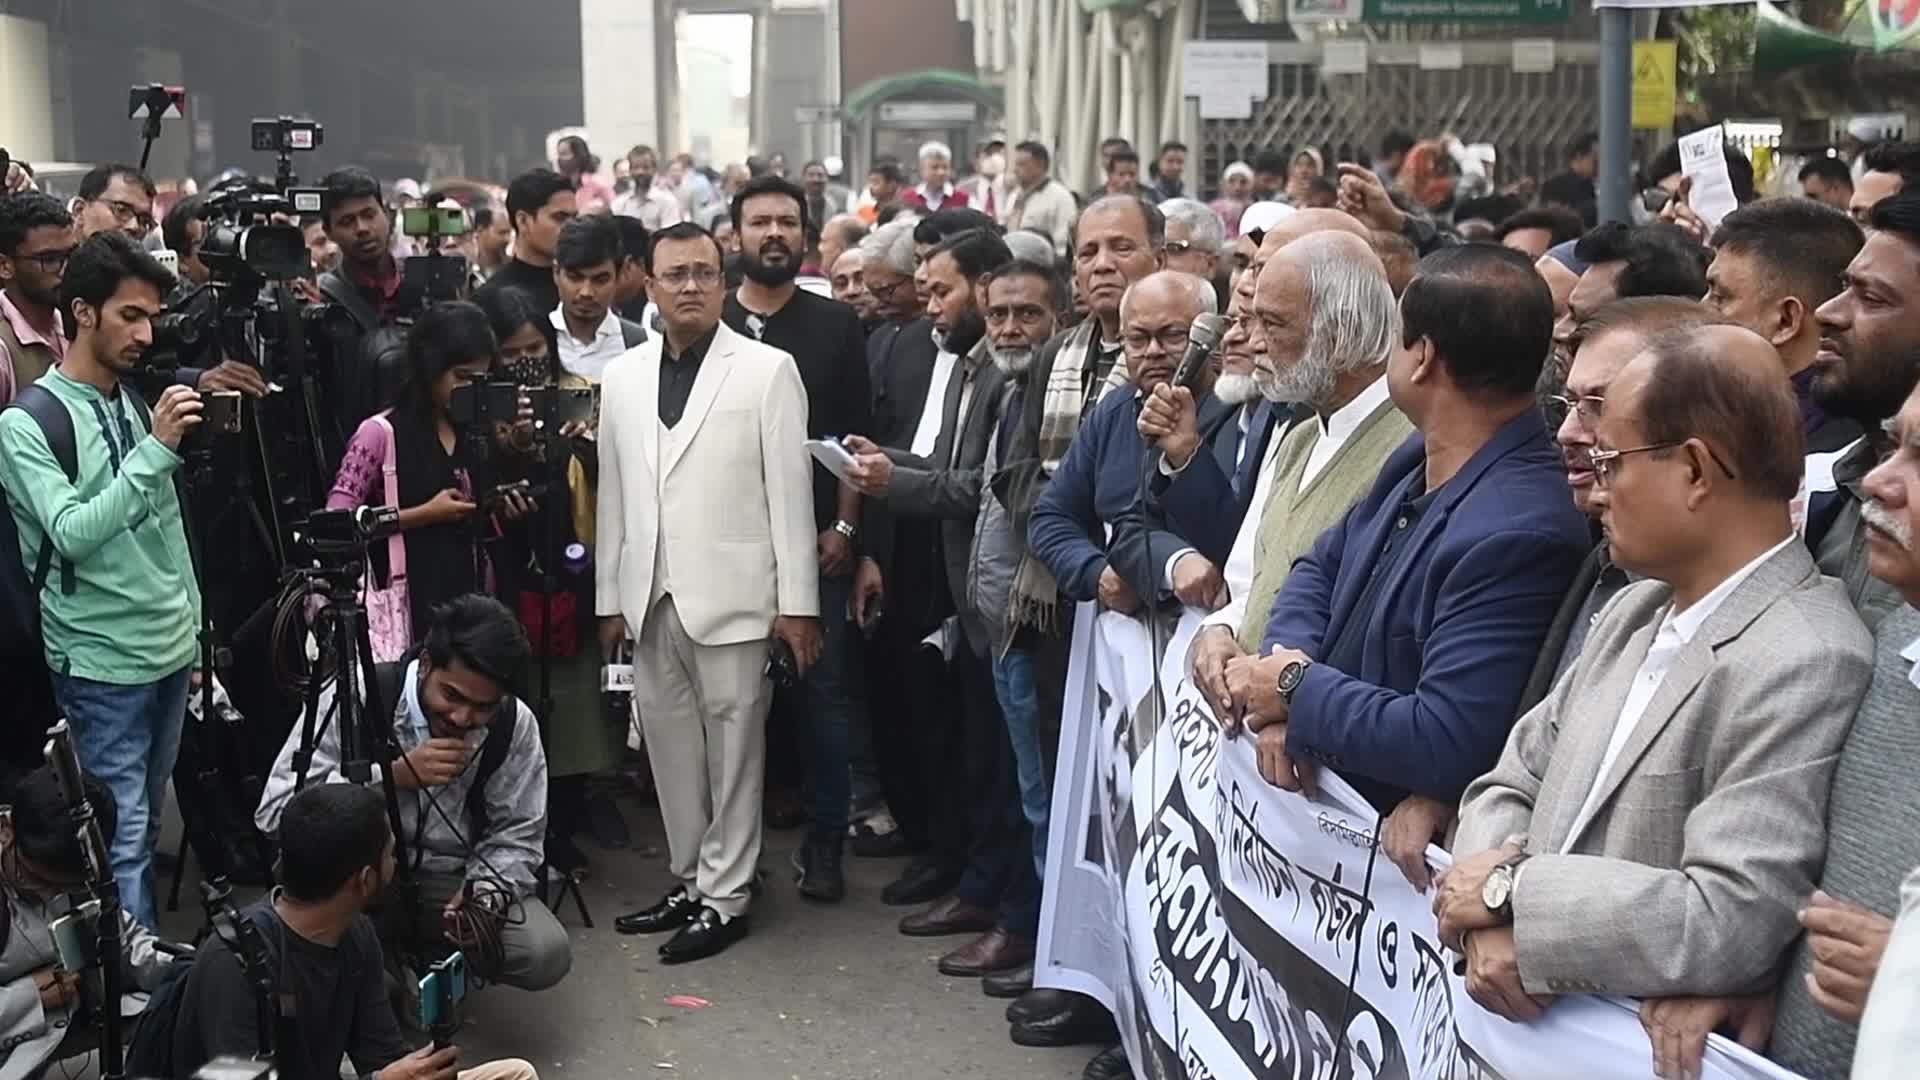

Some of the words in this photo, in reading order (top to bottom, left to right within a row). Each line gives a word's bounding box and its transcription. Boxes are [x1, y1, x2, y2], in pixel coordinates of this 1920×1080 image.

[1230, 780, 1302, 921] নির্বাচন
[1296, 862, 1376, 960] বর্জন
[1377, 919, 1399, 990] ও
[1317, 810, 1381, 850] বিসমিল্লাহি
